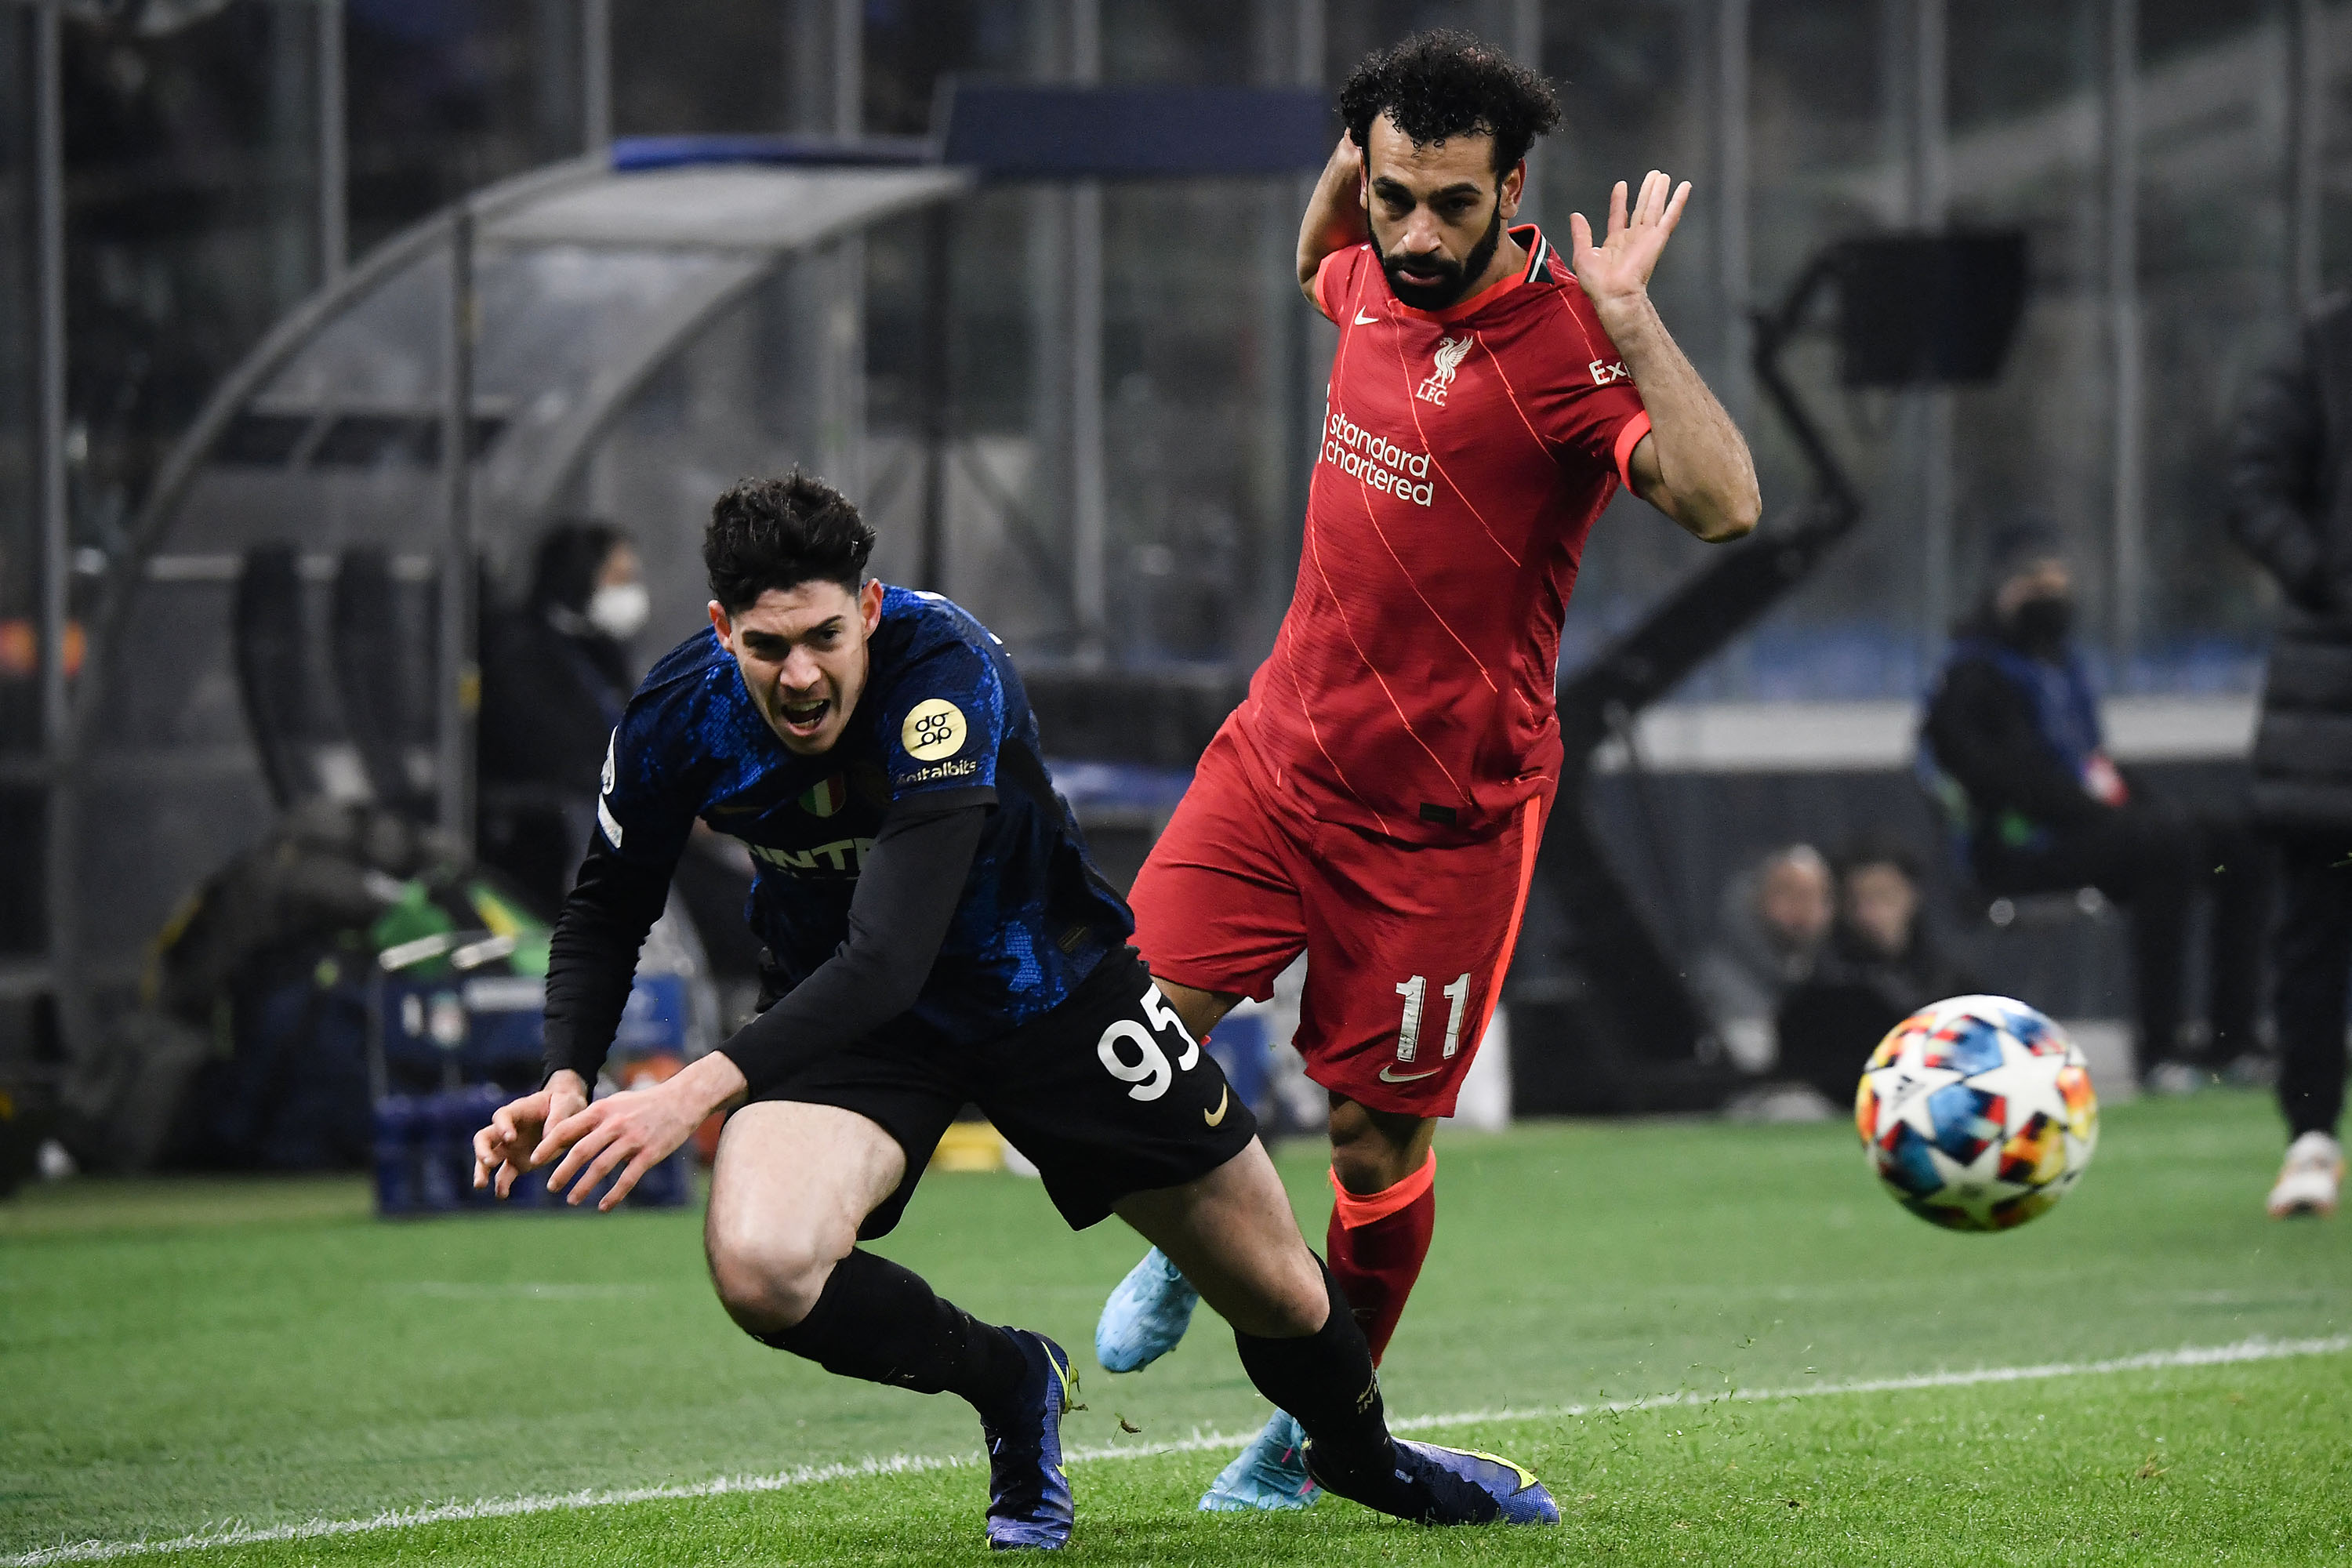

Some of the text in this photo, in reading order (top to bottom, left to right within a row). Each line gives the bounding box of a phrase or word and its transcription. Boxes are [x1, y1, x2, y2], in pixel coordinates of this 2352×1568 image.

[1588, 359, 1631, 385] Ex
[1326, 439, 1434, 507] chartered
[1329, 412, 1431, 479] standard
[1098, 982, 1200, 1102] 95
[1396, 973, 1472, 1062] 11
